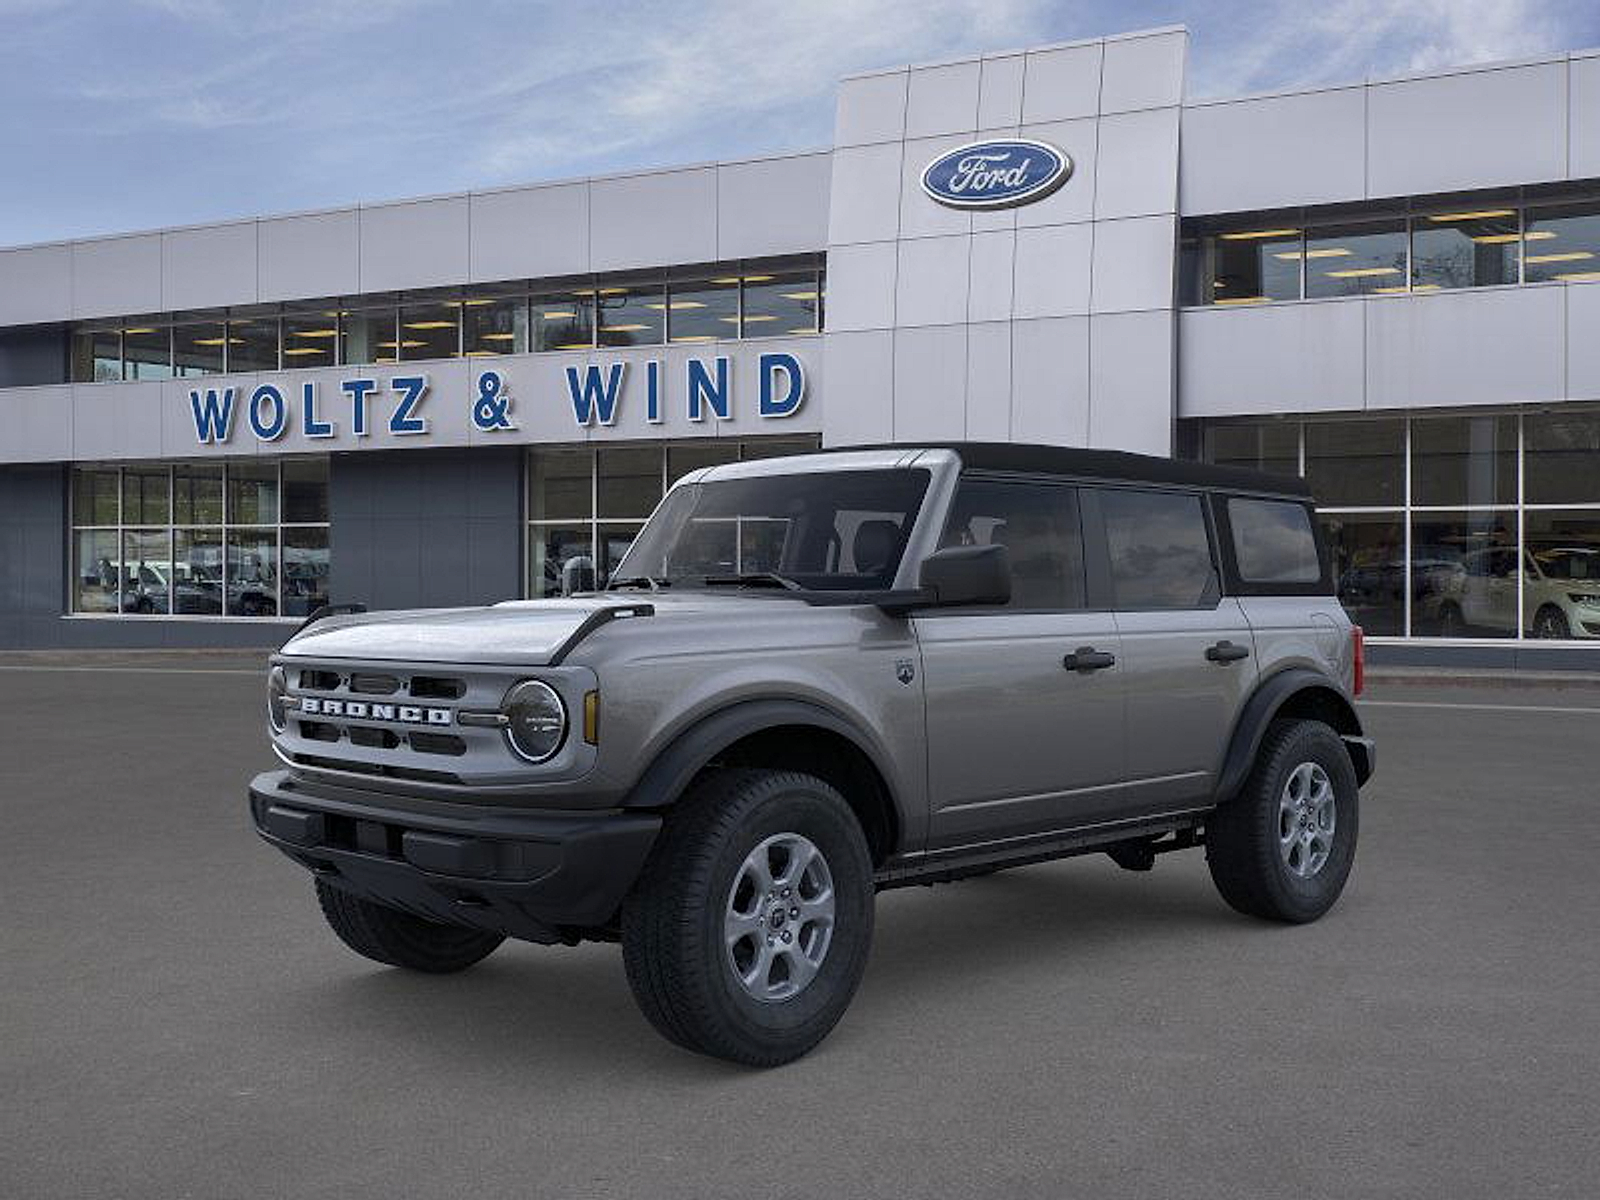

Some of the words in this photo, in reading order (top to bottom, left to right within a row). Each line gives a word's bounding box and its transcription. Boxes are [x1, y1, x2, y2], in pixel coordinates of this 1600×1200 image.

[950, 152, 1031, 193] Ford
[189, 373, 429, 443] WOLTZ
[472, 371, 516, 431] &
[565, 352, 805, 427] WIND
[301, 698, 451, 724] BRONCO
